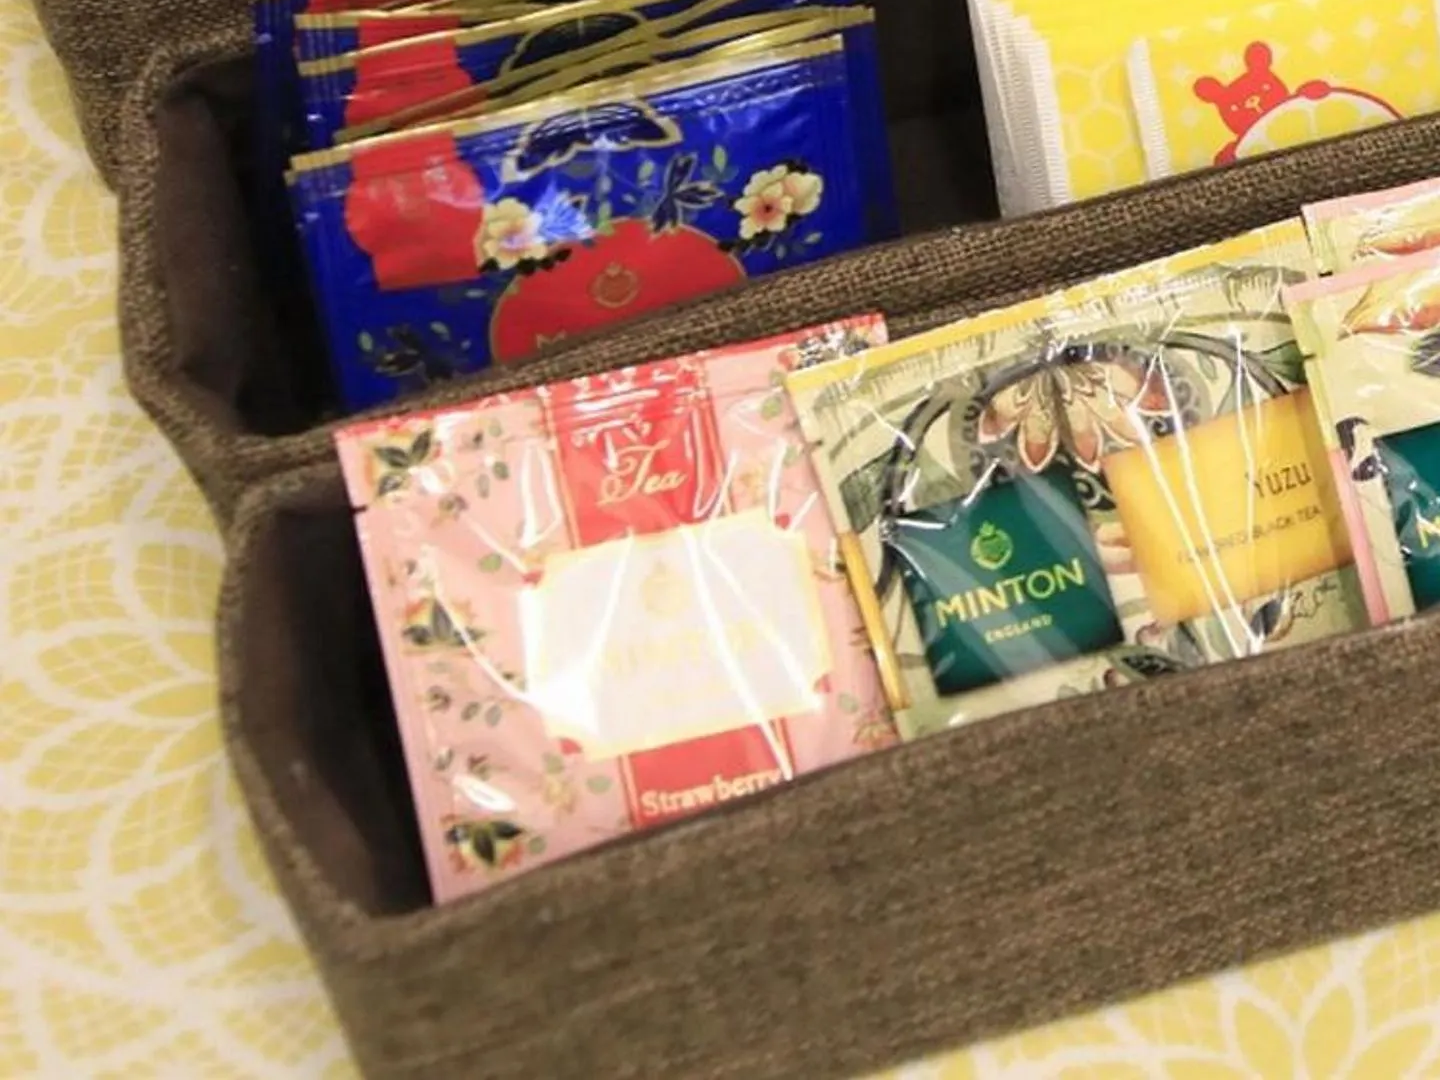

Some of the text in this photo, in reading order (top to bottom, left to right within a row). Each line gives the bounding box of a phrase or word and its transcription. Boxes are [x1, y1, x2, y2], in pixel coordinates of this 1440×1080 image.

[596, 439, 688, 506] Tea
[935, 557, 1085, 629] MINTON
[984, 613, 1053, 645] ENGLAND
